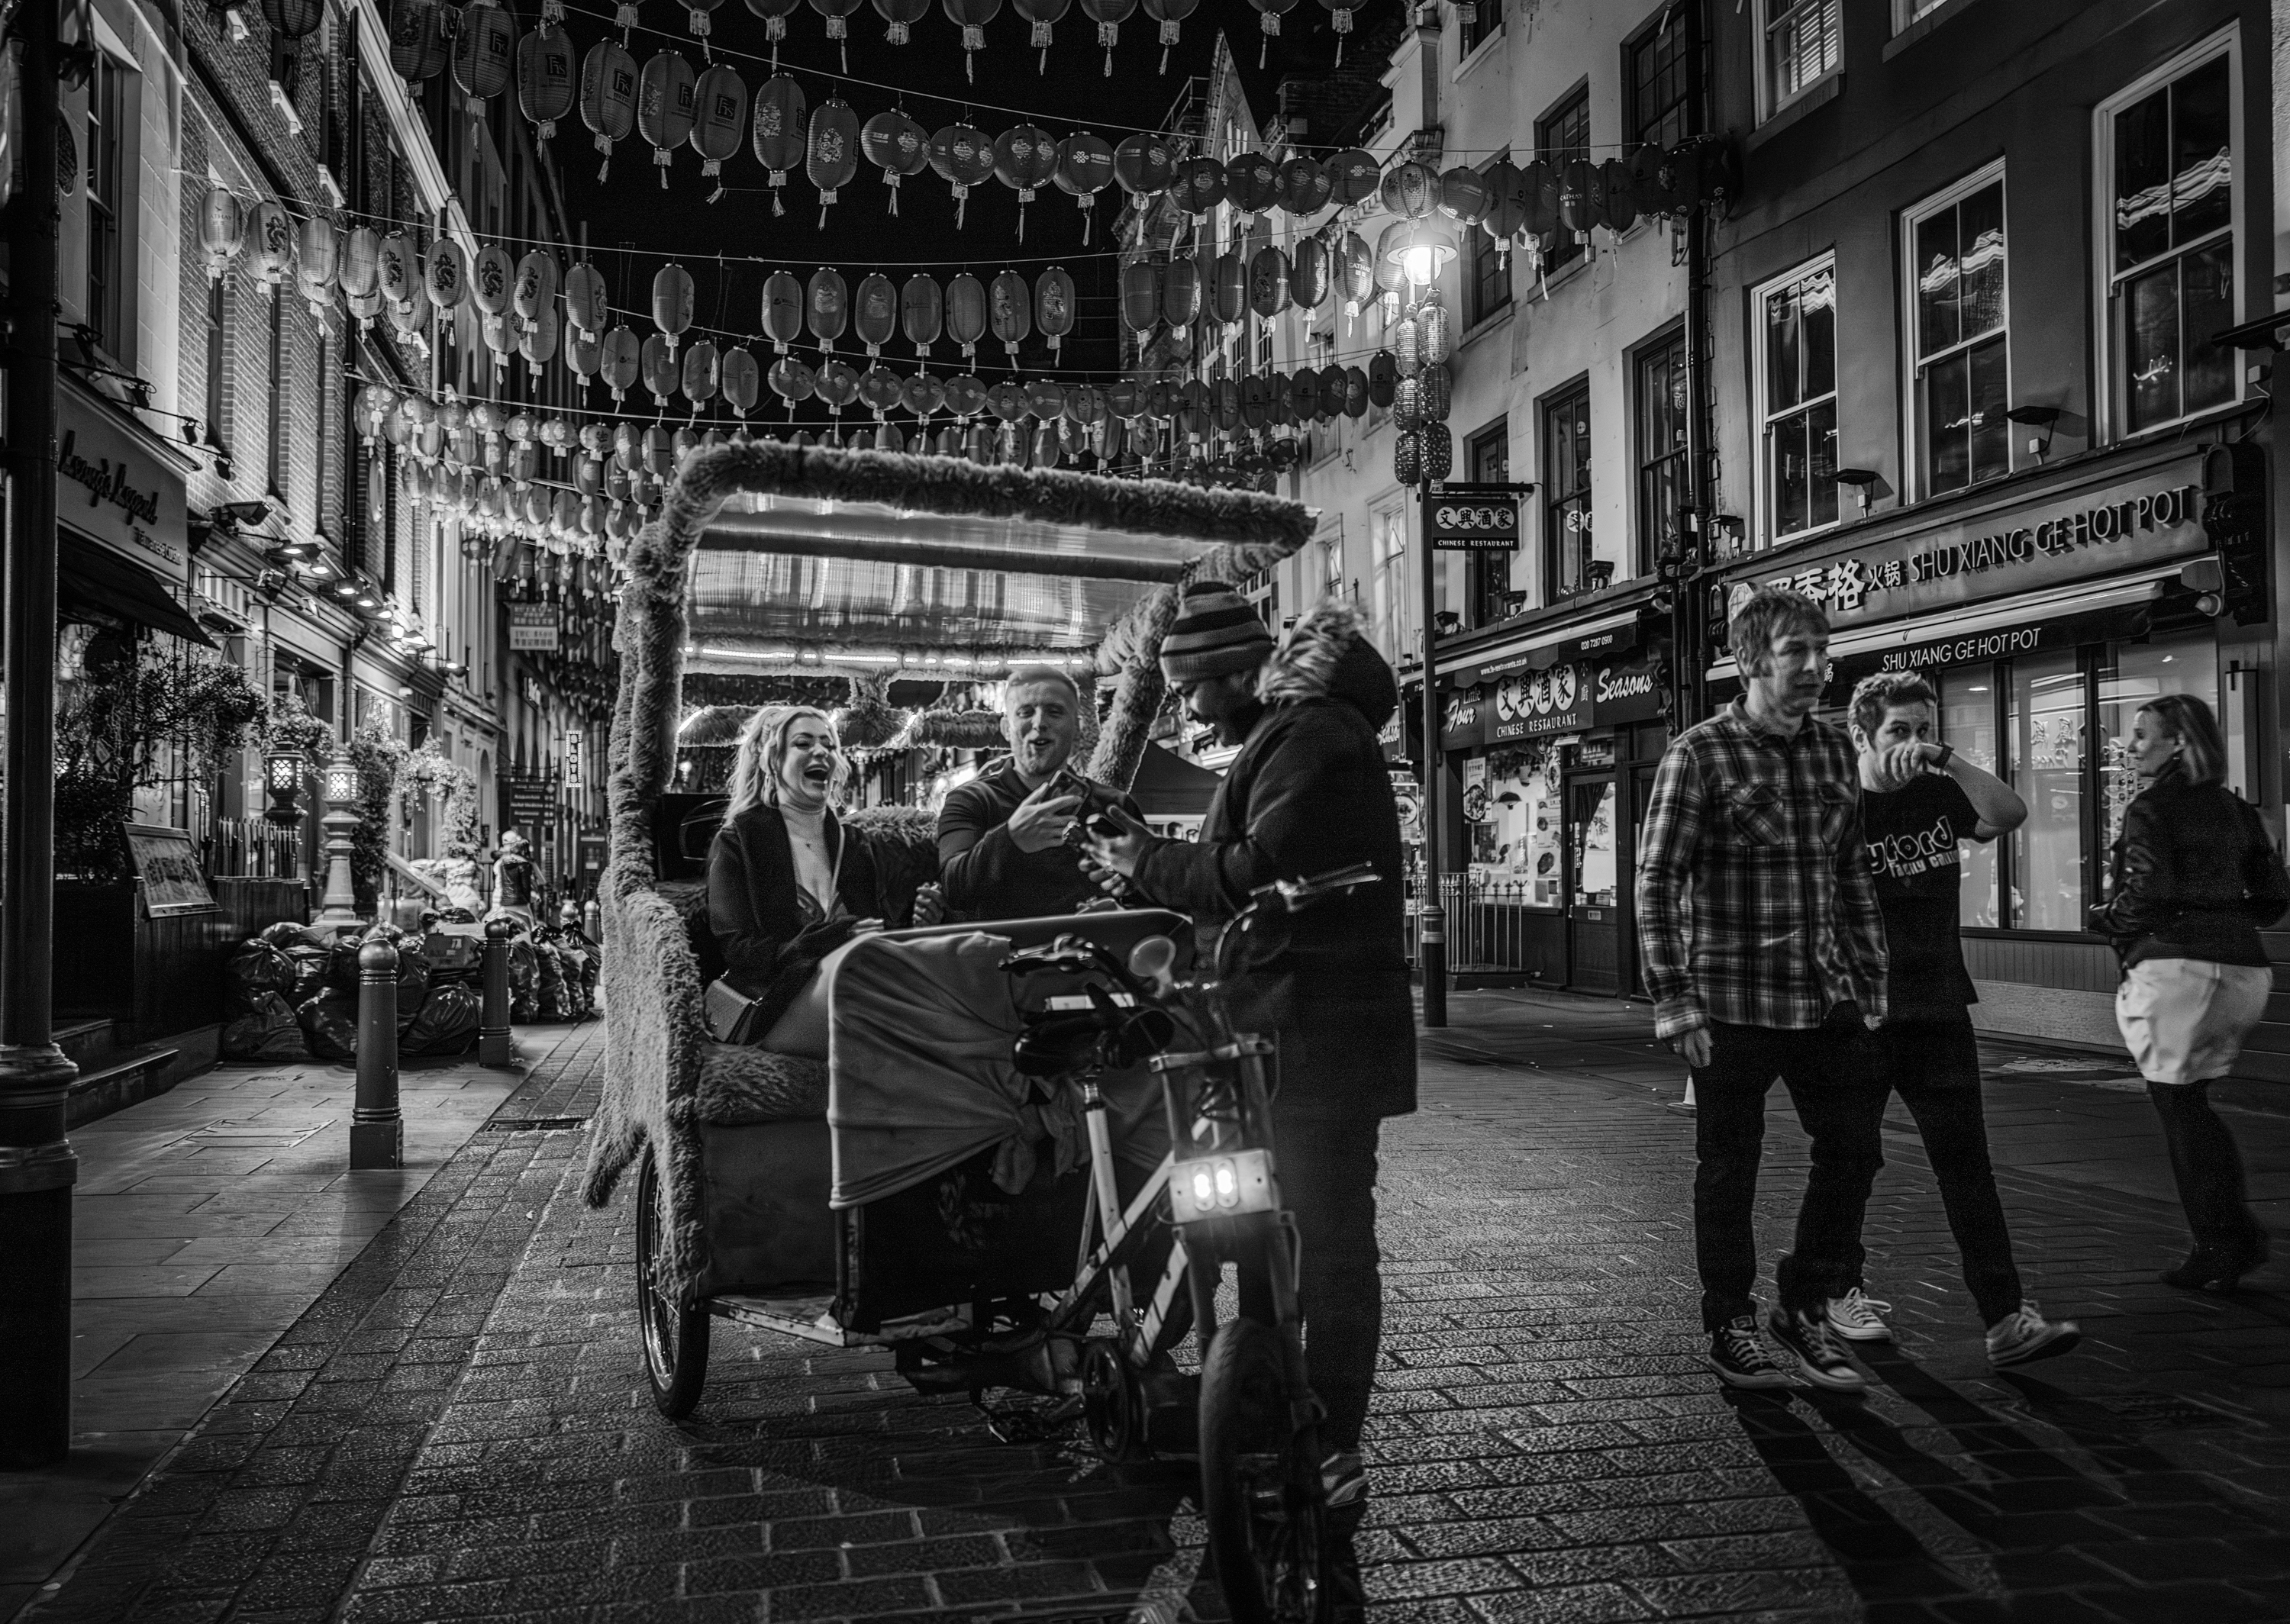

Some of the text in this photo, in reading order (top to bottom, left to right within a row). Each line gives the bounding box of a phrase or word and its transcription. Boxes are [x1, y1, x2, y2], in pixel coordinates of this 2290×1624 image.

[1347, 262, 1372, 273] CATHAY
[1439, 509, 1512, 527] 文興酒家
[1868, 560, 1901, 591] 火锅
[1910, 547, 1952, 582] SHU
[1959, 528, 2025, 571] XIANG
[2035, 519, 2065, 551] GE
[2073, 502, 2127, 543] HOT
[2137, 485, 2189, 528] POT
[1882, 627, 2041, 672] SHU XIANG GE HOT POT
[1463, 686, 1482, 704] Little
[1500, 665, 1572, 713] 文興酒家
[1596, 668, 1654, 703] Seasons
[1448, 698, 1476, 733] Four
[1497, 713, 1577, 738] CHINESE RESTAURANT
